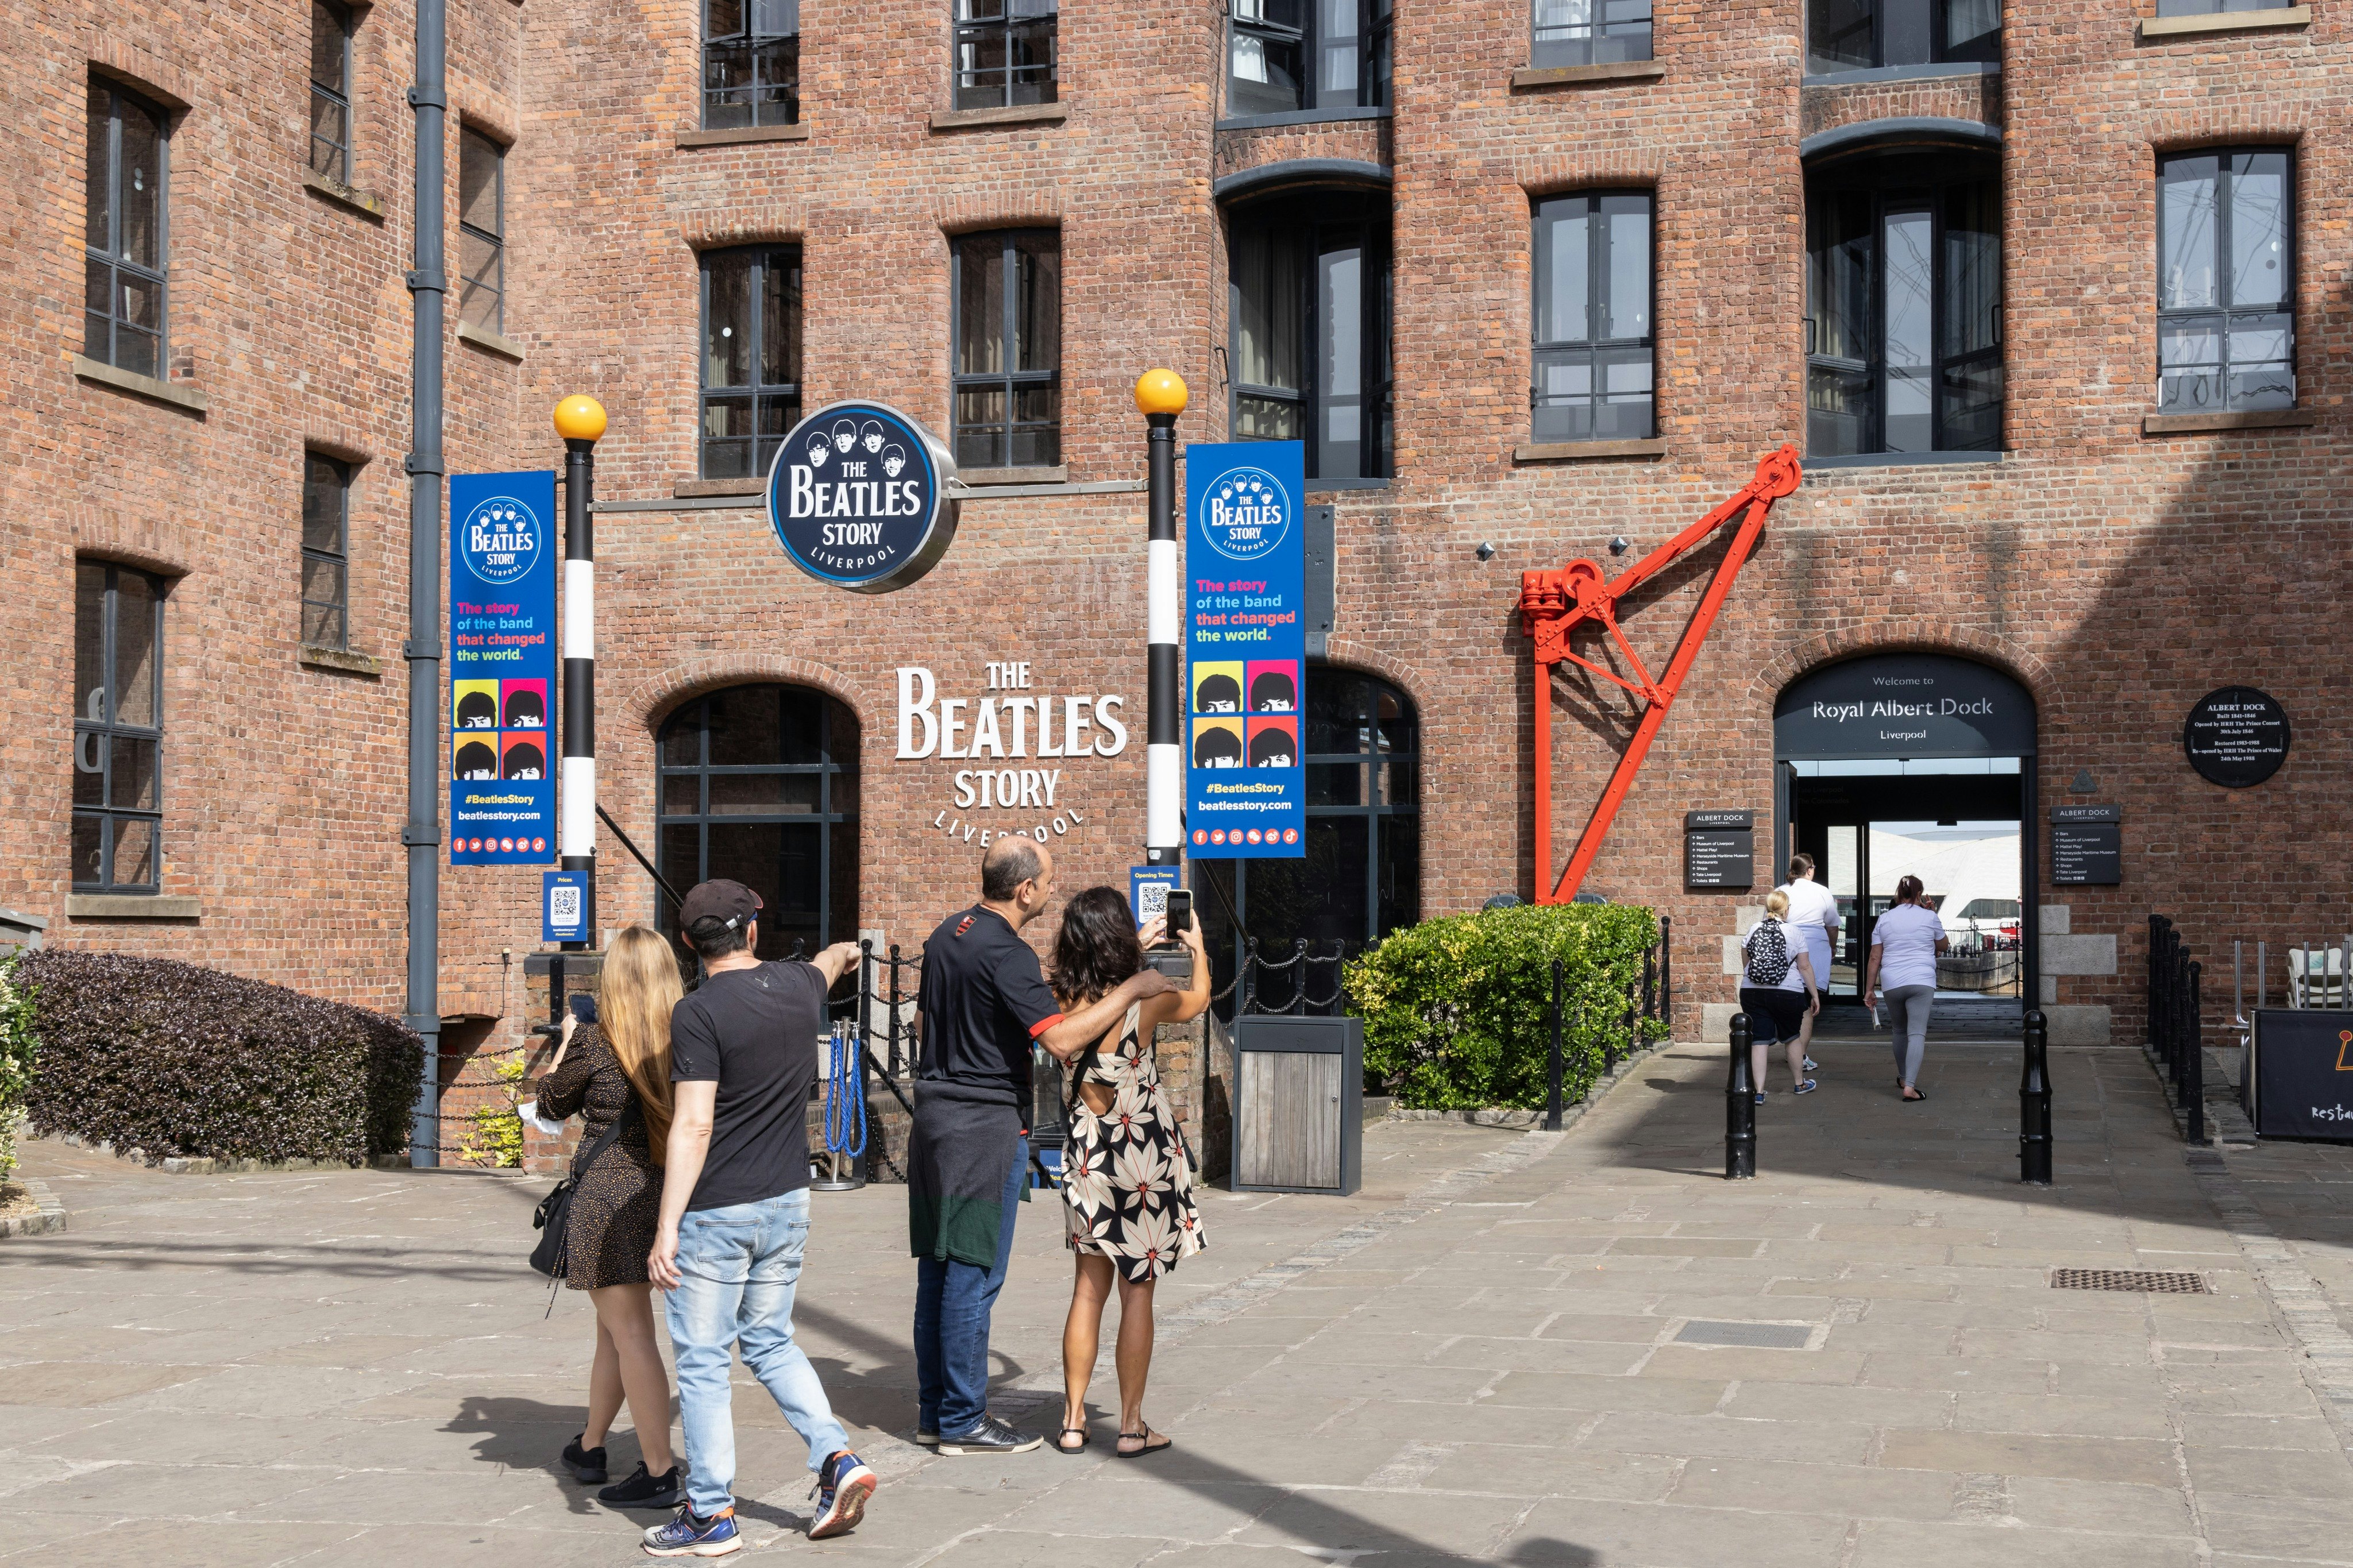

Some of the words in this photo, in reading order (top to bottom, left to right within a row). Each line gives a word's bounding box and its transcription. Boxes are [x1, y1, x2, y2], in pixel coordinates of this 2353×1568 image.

[842, 462, 867, 477] THE
[789, 465, 920, 517] BEATLES
[1239, 496, 1252, 504] THE
[1212, 498, 1281, 526] BEATLES
[495, 524, 507, 532] THE
[823, 523, 883, 545] STORY
[1230, 528, 1262, 540] STORY
[471, 526, 533, 552] BEATLES
[1224, 538, 1268, 551] LIVERPOOL
[487, 554, 515, 565] STORY
[811, 546, 895, 569] LIVERPOOL
[482, 565, 522, 576] LIVERPOOL
[1196, 580, 1224, 592] The
[1228, 580, 1266, 593] story
[1196, 596, 1211, 609] of
[1215, 596, 1240, 608] the
[1244, 594, 1281, 607] band
[457, 603, 482, 614] The
[486, 603, 519, 616] story
[458, 619, 470, 629] of
[475, 618, 496, 629] the
[500, 617, 533, 628] band
[1196, 613, 1226, 625] that
[1230, 611, 1295, 627] changed
[457, 634, 484, 646] that
[487, 632, 545, 647] changed
[1196, 630, 1220, 642] the
[1224, 628, 1271, 641] world.
[457, 650, 478, 661] the
[483, 649, 523, 660] world.
[985, 662, 1031, 689] THE
[1873, 677, 1920, 686] Welcome
[895, 667, 1127, 759] BEATLES
[1813, 700, 1863, 722] Royal
[1871, 700, 1932, 717] Albert
[1941, 698, 1993, 715] Dock
[1881, 730, 1926, 741] Liverpool
[955, 769, 1062, 808] STORY
[1206, 783, 1284, 794] #BeatlesStory
[465, 795, 534, 806] #BeatlesStory
[1198, 801, 1291, 812] beatlesstory.com
[458, 811, 540, 821] beatlesstory.com
[934, 809, 1083, 848] LIVEOOL
